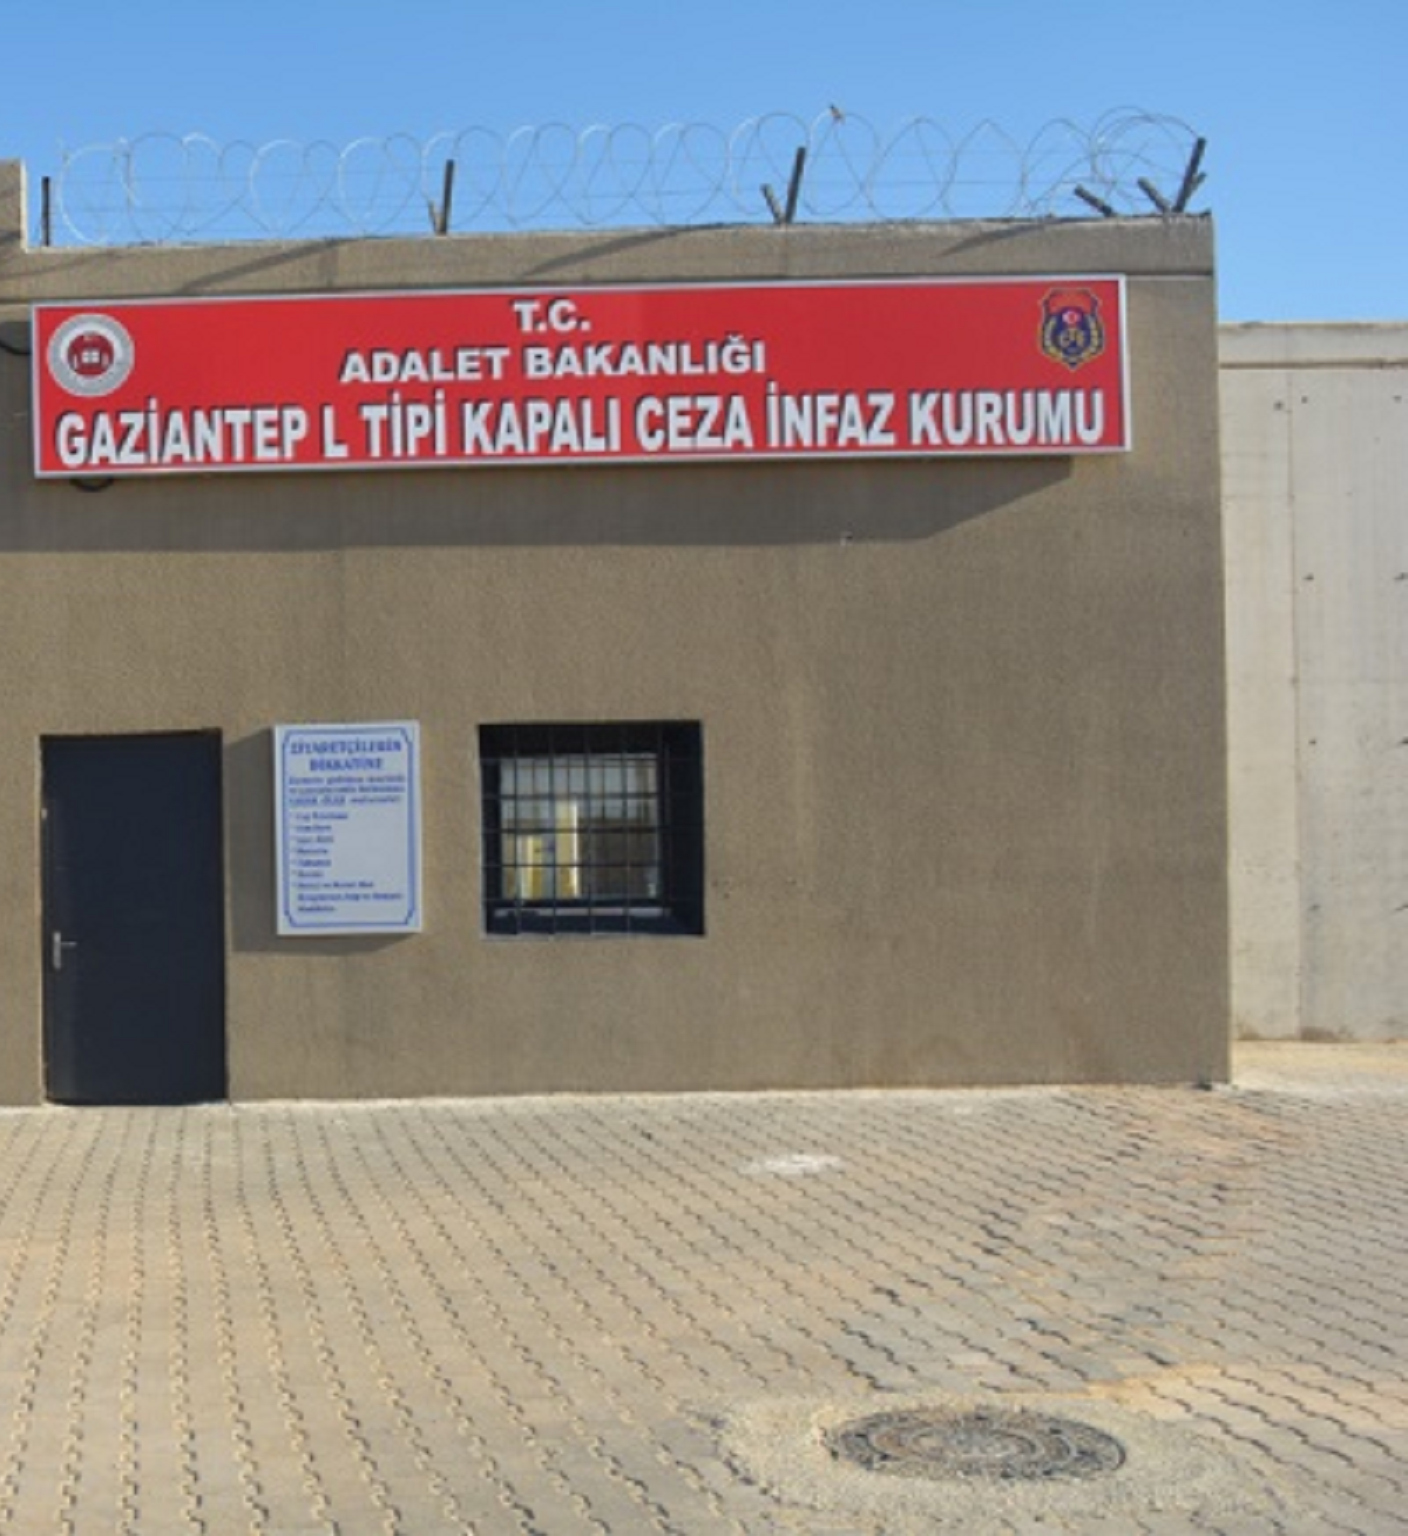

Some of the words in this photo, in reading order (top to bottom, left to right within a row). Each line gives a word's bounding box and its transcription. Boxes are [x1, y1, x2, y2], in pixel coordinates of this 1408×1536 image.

[513, 300, 591, 332] T.C.
[341, 348, 510, 383] ADALET
[526, 336, 766, 378] BAKANLIĞI
[57, 398, 309, 468] GAZİANTEP
[323, 405, 349, 459] L
[361, 389, 447, 458] TİPİ
[463, 398, 621, 456] KAPALI
[635, 395, 754, 452] CEZA
[767, 381, 897, 448] İNFAZ
[910, 389, 1104, 446] KURUMU
